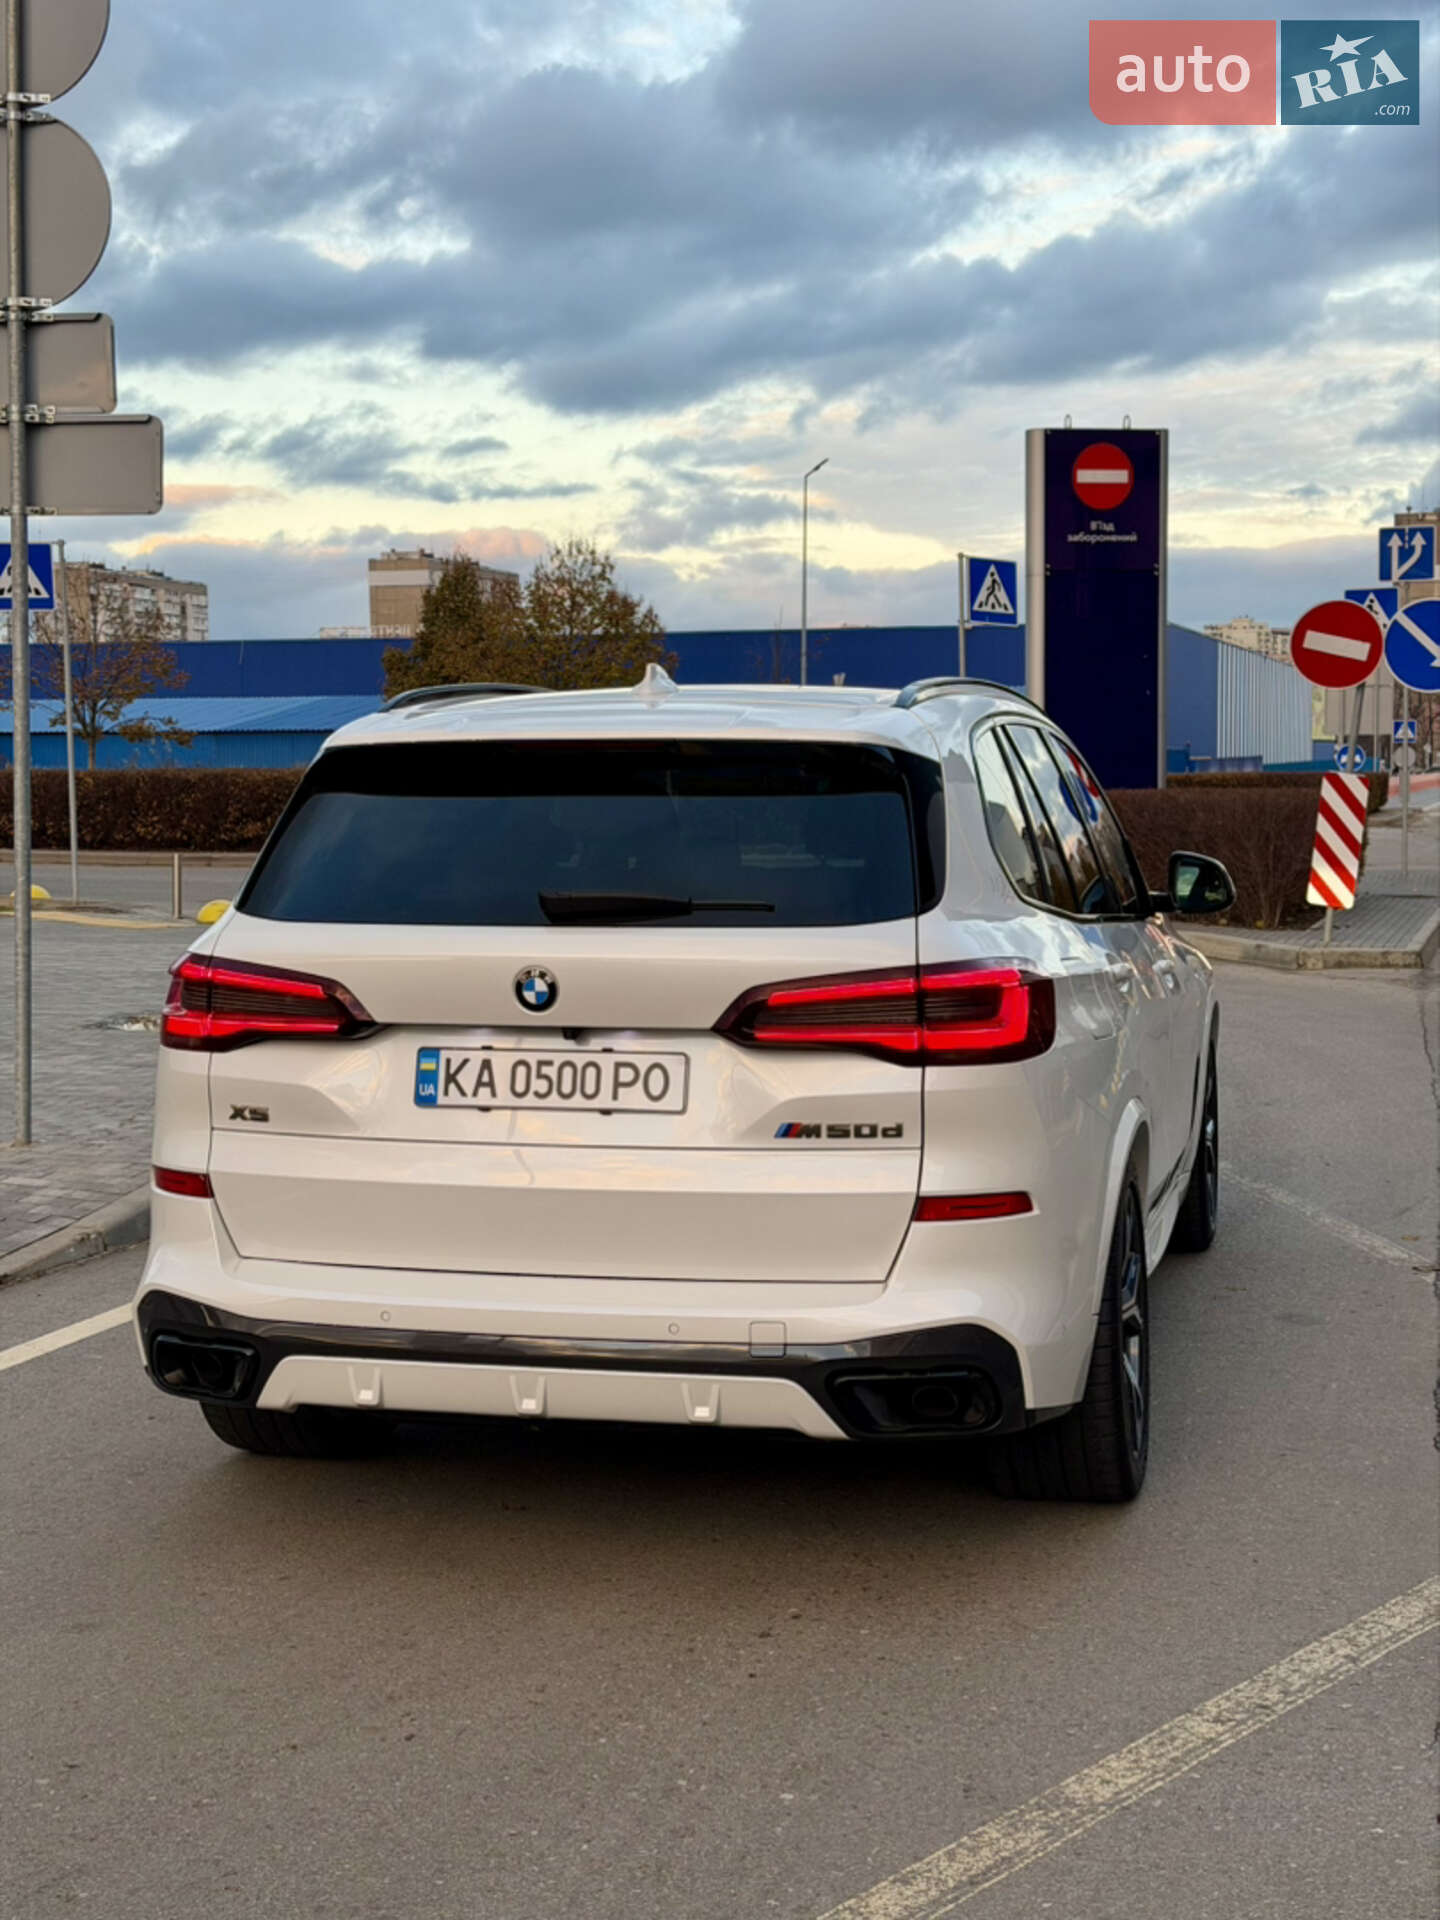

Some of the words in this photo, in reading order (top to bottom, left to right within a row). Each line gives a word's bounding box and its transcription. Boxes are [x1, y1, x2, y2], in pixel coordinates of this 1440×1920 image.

[510, 1059, 601, 1100] 0500
[419, 1083, 436, 1096] UA
[228, 1104, 269, 1123] X5
